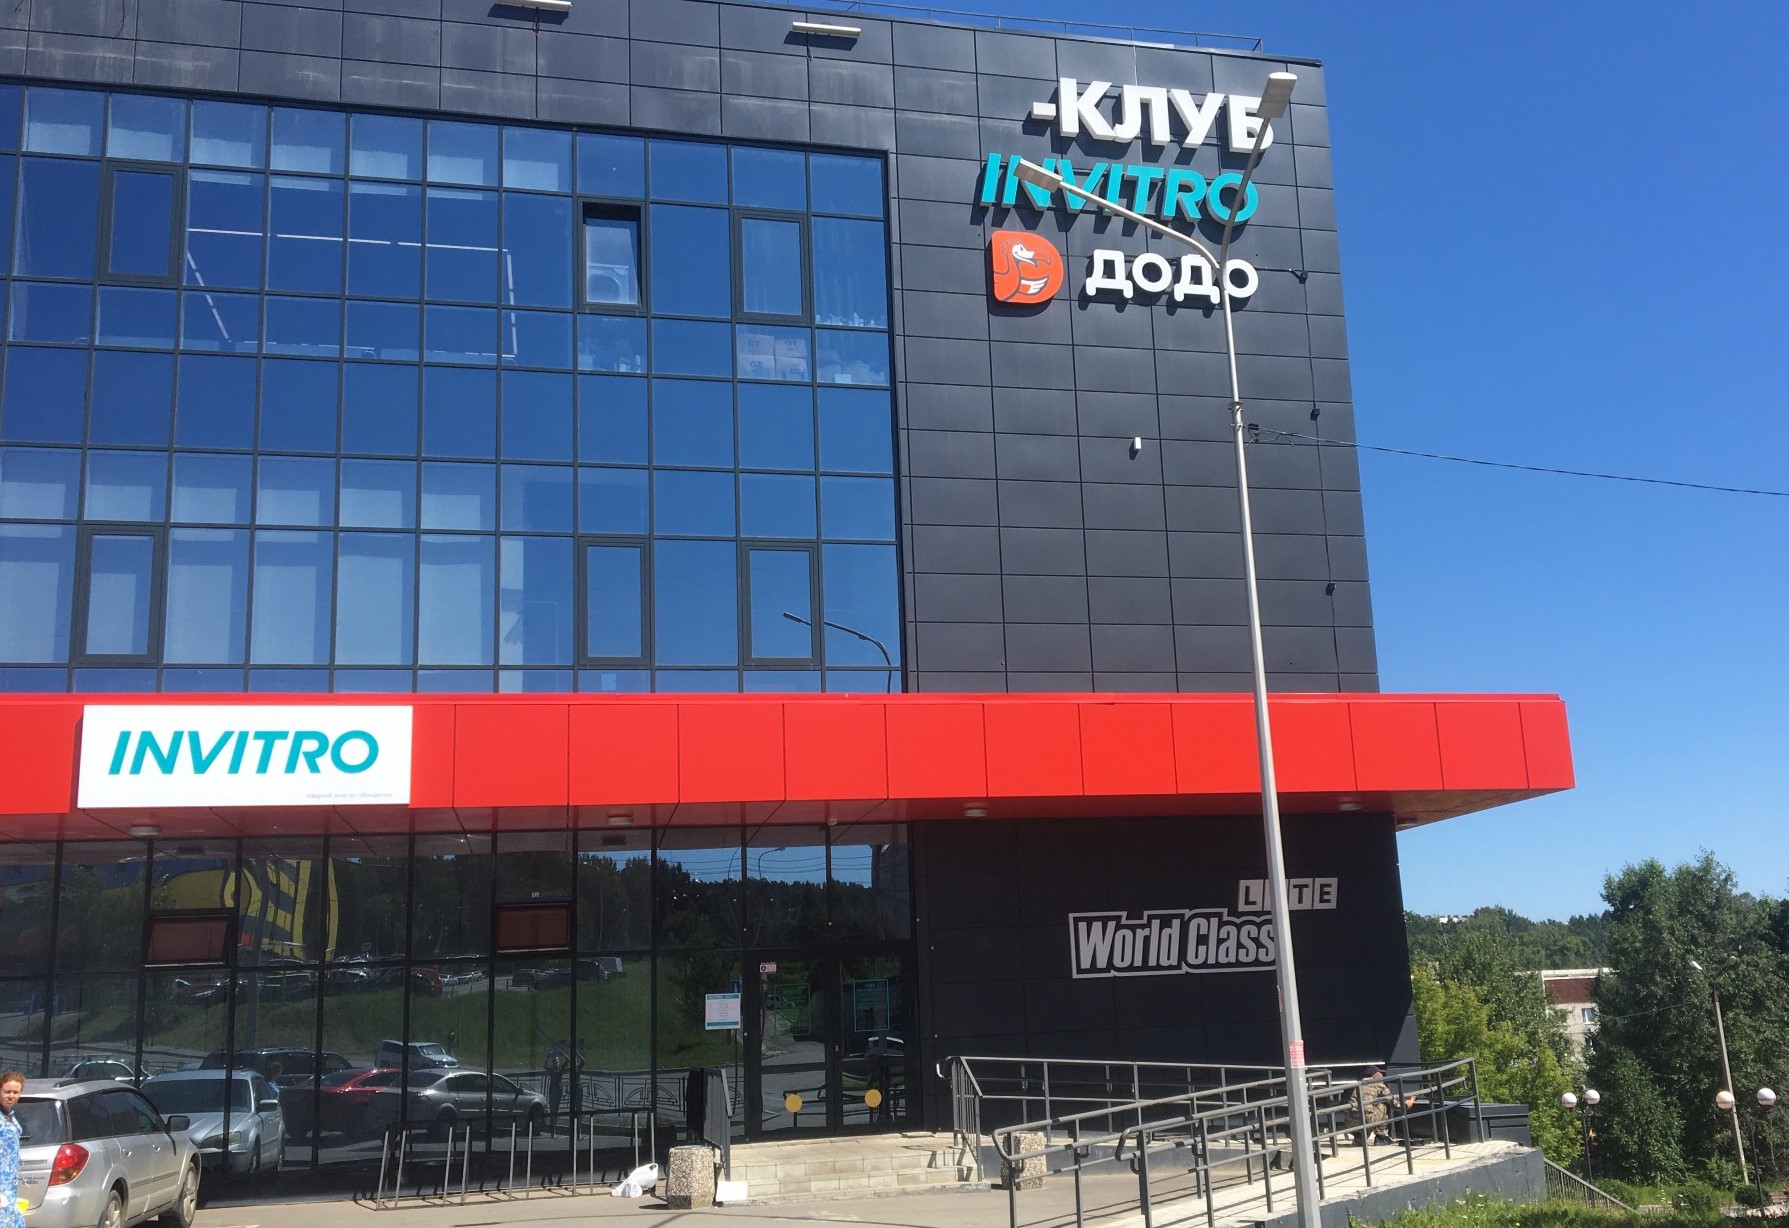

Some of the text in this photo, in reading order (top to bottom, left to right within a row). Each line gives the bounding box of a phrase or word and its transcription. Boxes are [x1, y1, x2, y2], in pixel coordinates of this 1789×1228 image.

[1031, 77, 1274, 154] -КЛУБ
[979, 152, 1259, 226] INVITRO
[1086, 248, 1259, 304] ДОДО
[108, 729, 379, 775] INVITRO
[1244, 883, 1333, 906] LTE
[1077, 916, 1277, 970] World Class
